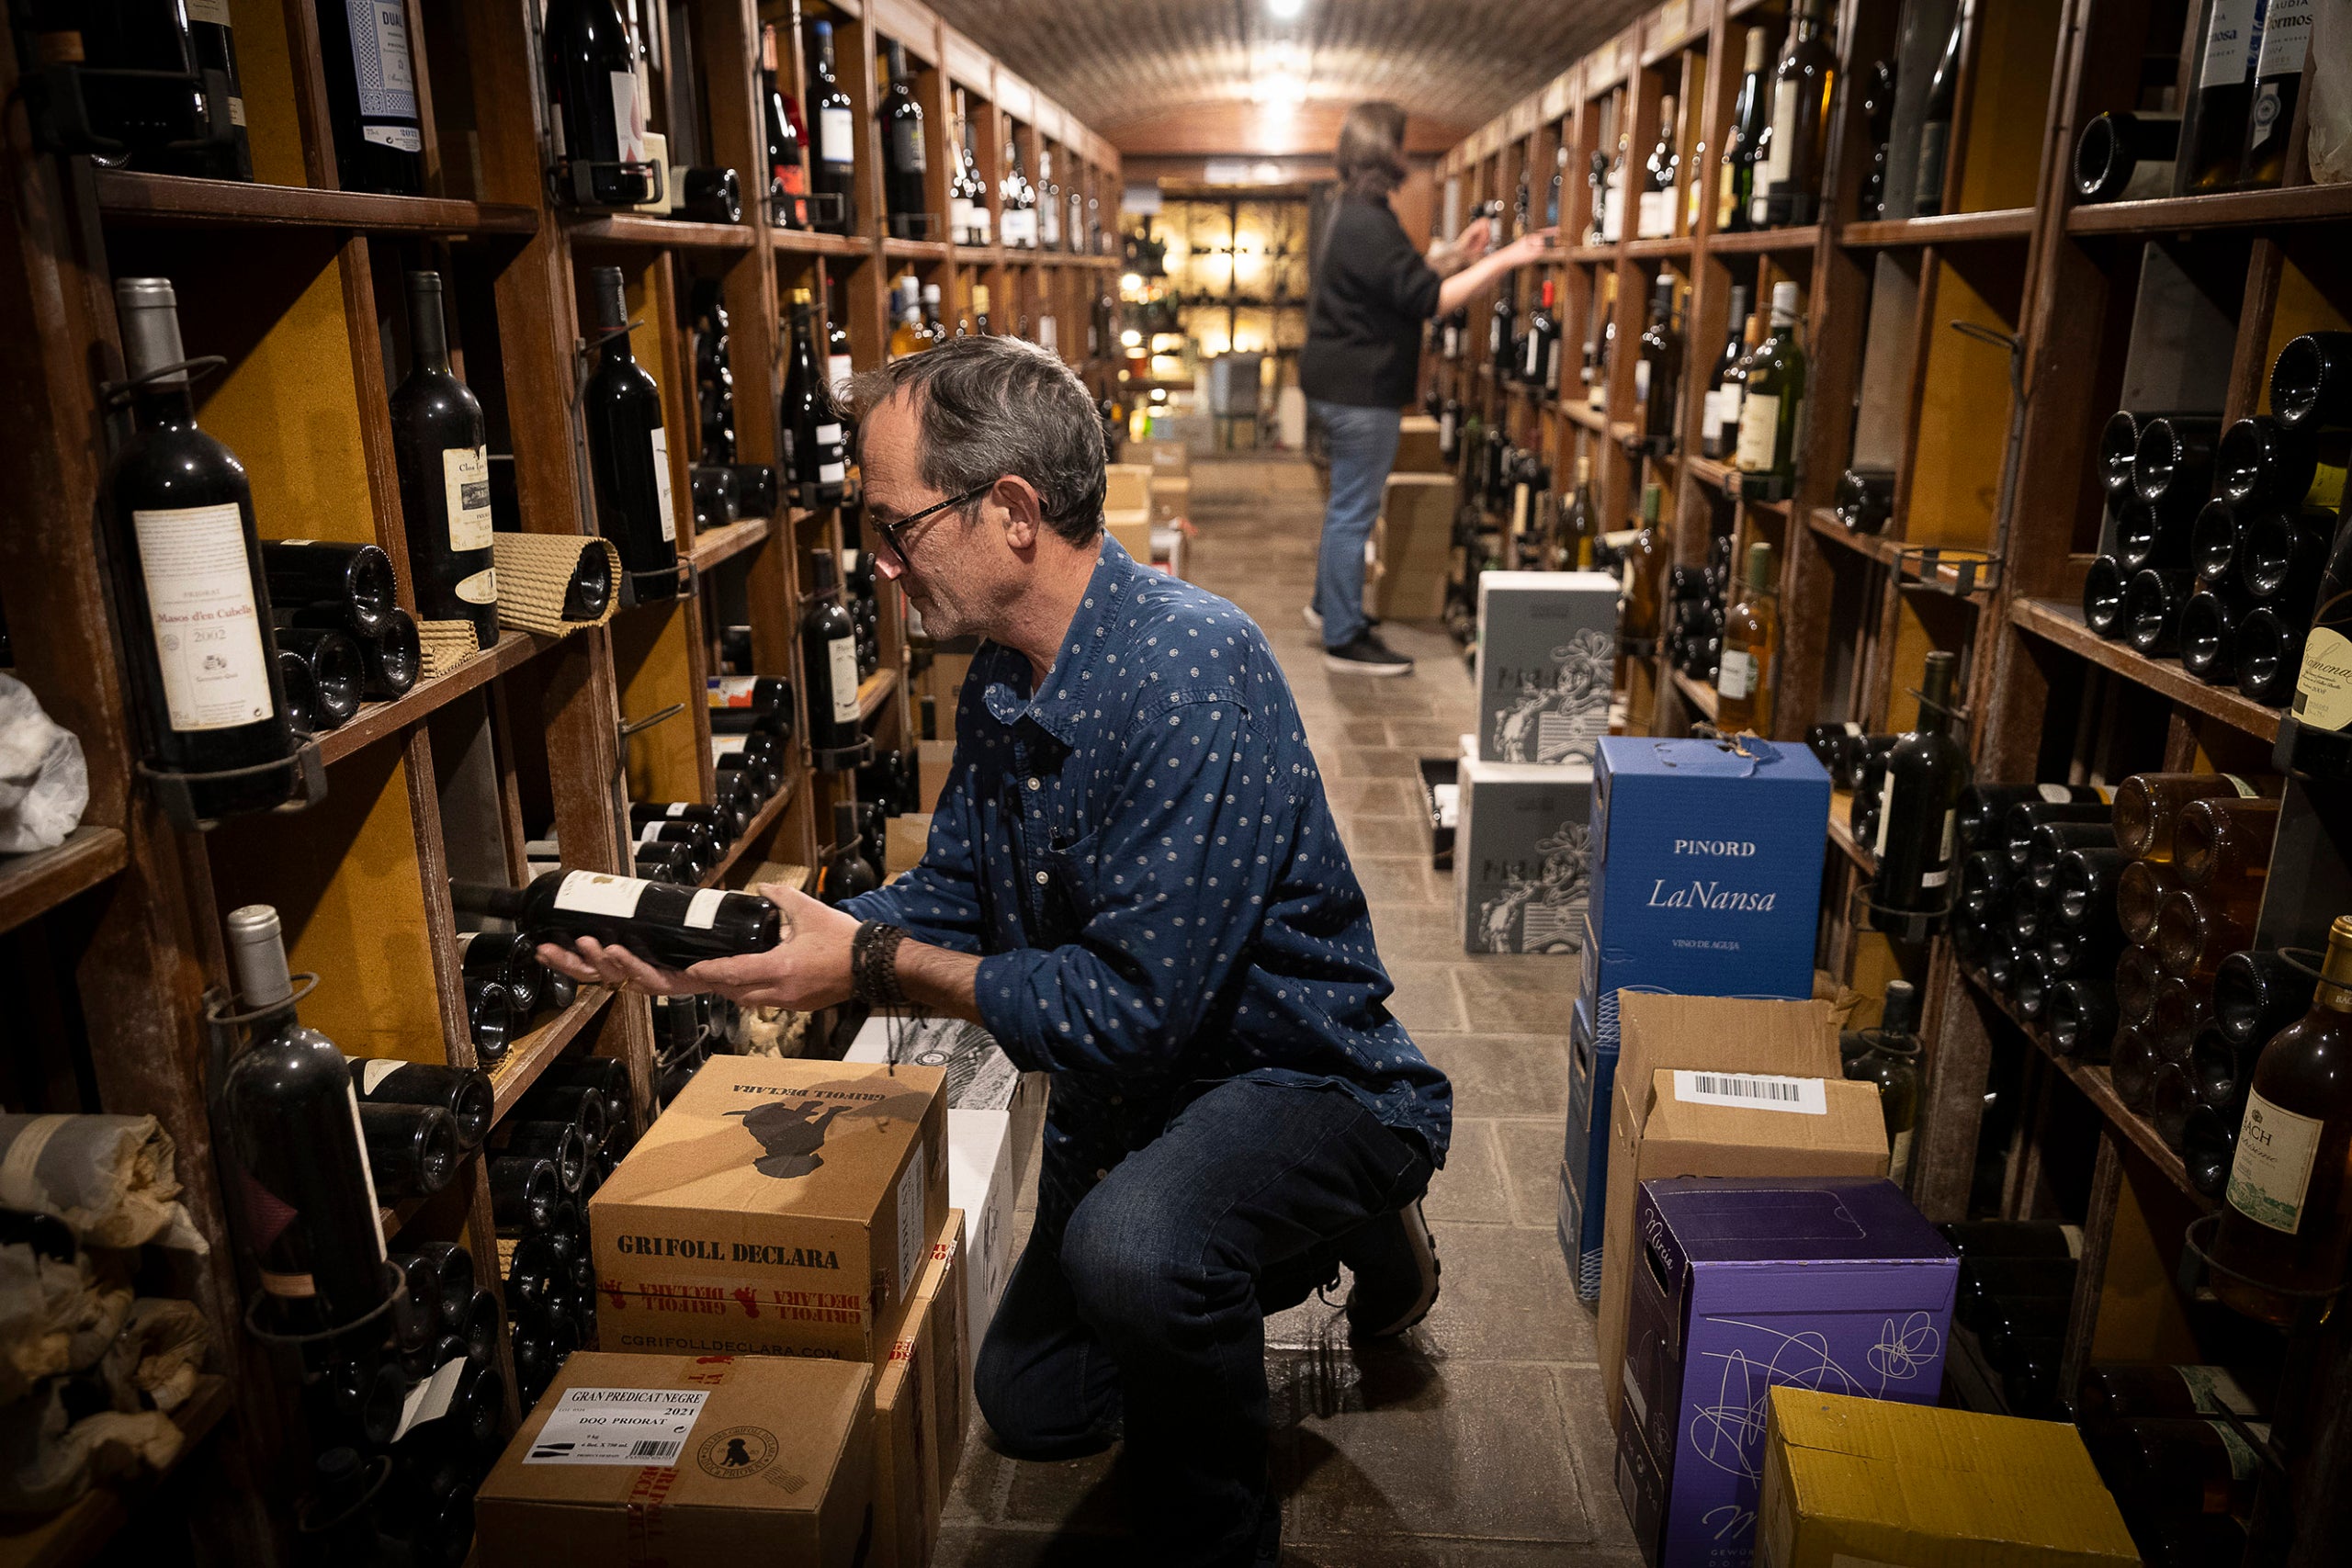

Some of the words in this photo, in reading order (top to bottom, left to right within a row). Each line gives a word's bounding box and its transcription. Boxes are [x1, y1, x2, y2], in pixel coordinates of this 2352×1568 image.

[1673, 839, 1757, 857] PINORD
[1645, 879, 1777, 911] LaNansa
[1696, 940, 1710, 948] DE
[733, 1084, 808, 1098] DECLARA
[814, 1090, 887, 1101] GRIFOLL
[1645, 1207, 1673, 1270] Mircia
[616, 1235, 725, 1261] GRIFOLL
[731, 1243, 840, 1269] DECLARA
[639, 1282, 724, 1301] DECLARA
[773, 1290, 861, 1311] DECLARA
[642, 1296, 727, 1316] GRIFOLL
[775, 1306, 862, 1325] GRIFOLL
[571, 1391, 603, 1402] GRAN
[603, 1391, 663, 1403] PREDICAT
[662, 1393, 703, 1404] NEGRE
[663, 1407, 695, 1416] 2021
